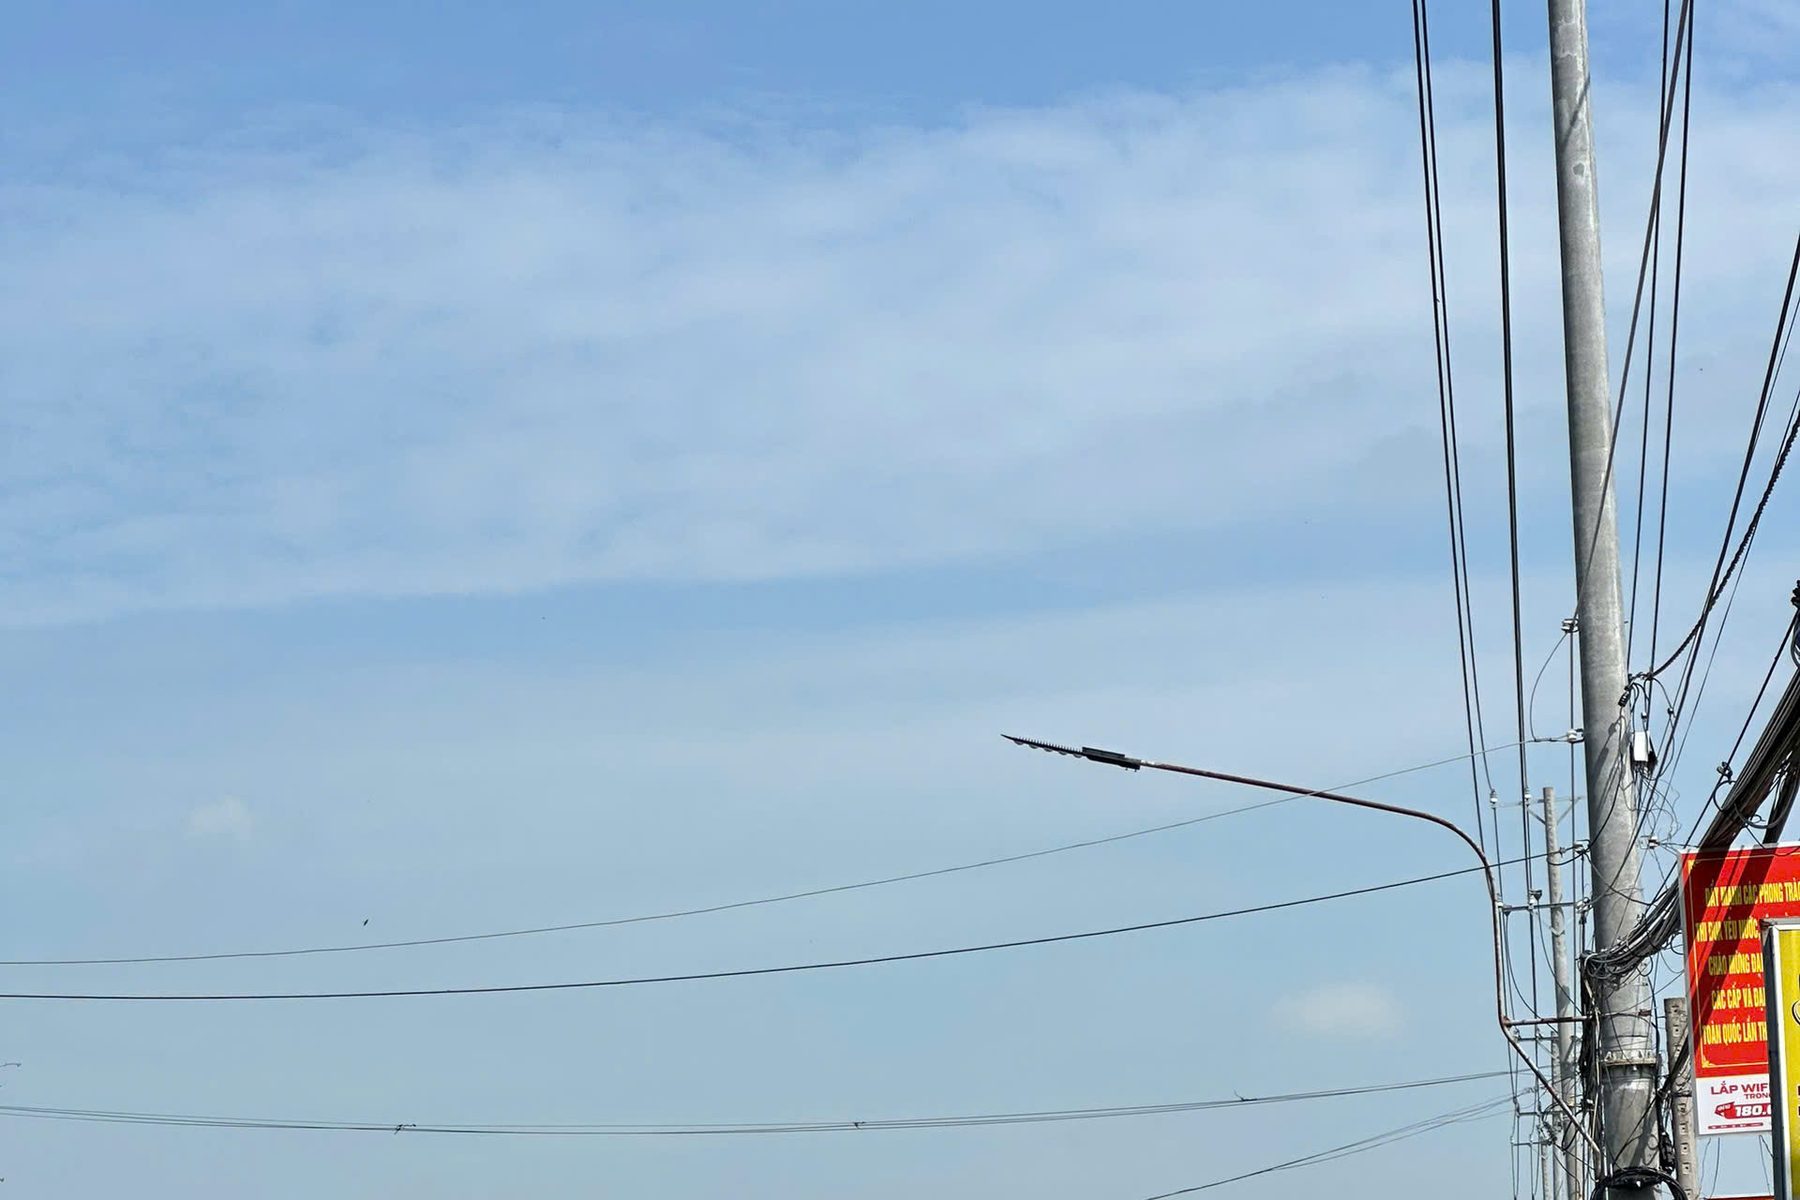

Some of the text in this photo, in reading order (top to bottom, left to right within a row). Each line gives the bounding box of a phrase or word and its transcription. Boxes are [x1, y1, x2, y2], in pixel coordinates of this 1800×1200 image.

[1759, 883, 1783, 903] PHONG
[1742, 984, 1753, 1008] VÀ
[1702, 1020, 1721, 1045] TOÀN
[1722, 1016, 1742, 1045] QUỐC
[1711, 1080, 1768, 1095] LẮP WIF
